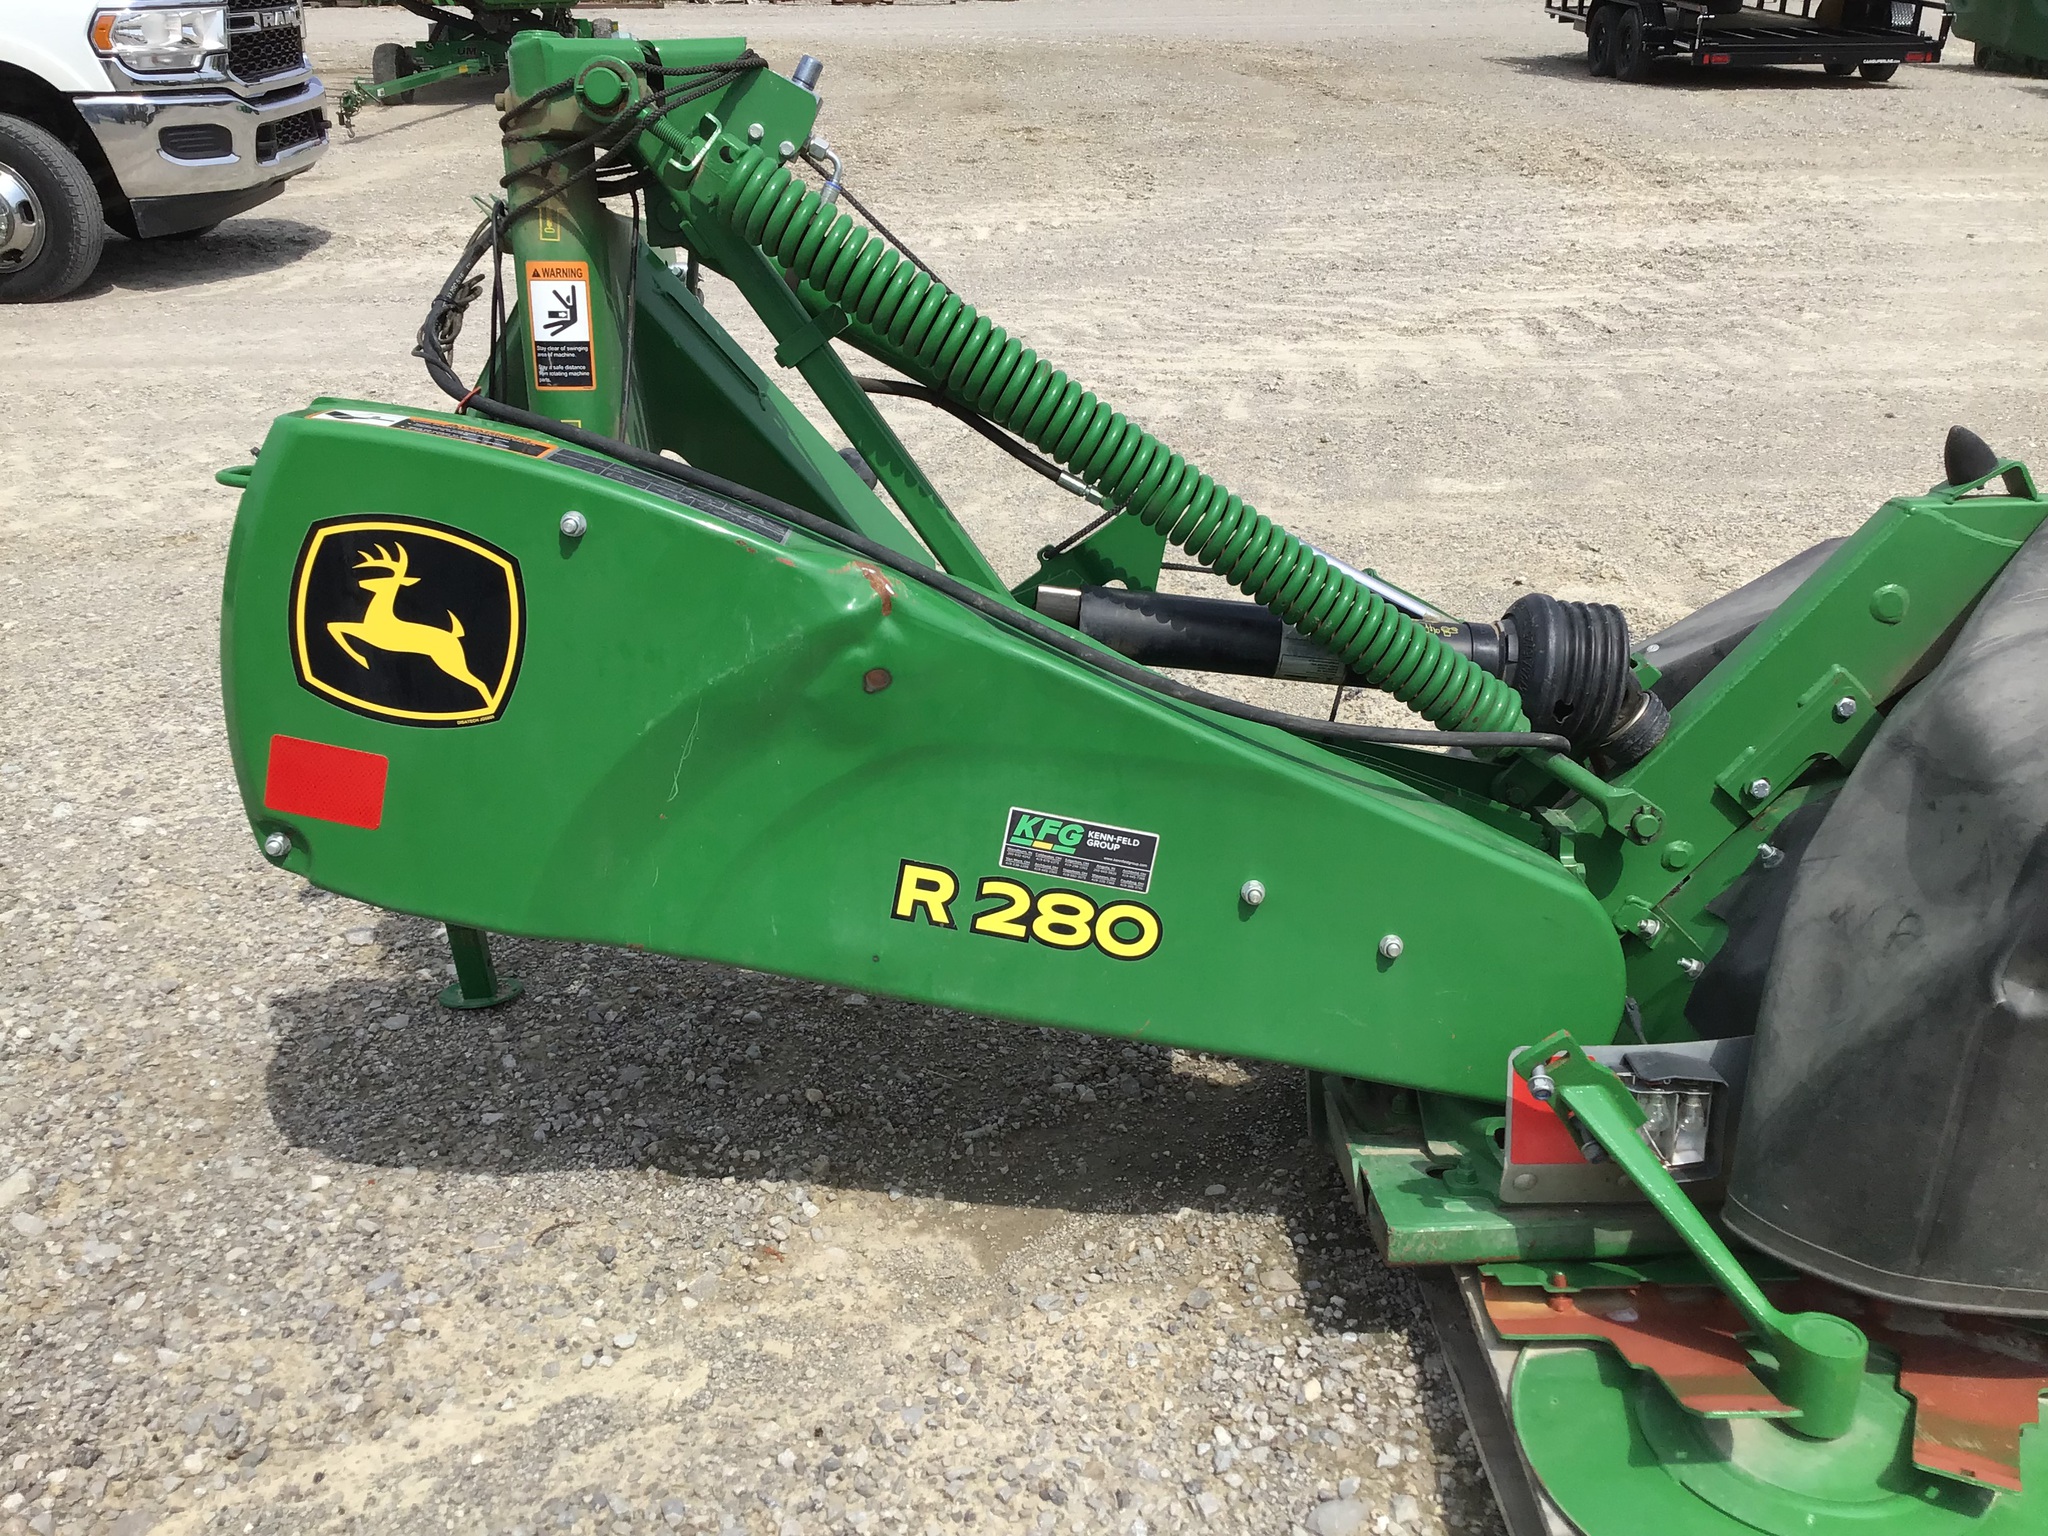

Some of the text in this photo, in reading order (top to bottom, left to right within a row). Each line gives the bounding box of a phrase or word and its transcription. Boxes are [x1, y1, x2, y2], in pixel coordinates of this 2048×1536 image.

[262, 10, 300, 28] RAM
[541, 267, 583, 279] WARNING
[536, 345, 547, 353] Stay
[1012, 814, 1085, 846] KFG
[1087, 830, 1141, 848] KENN-FELD
[1086, 840, 1121, 852] GROUP
[891, 860, 1163, 961] R 280
